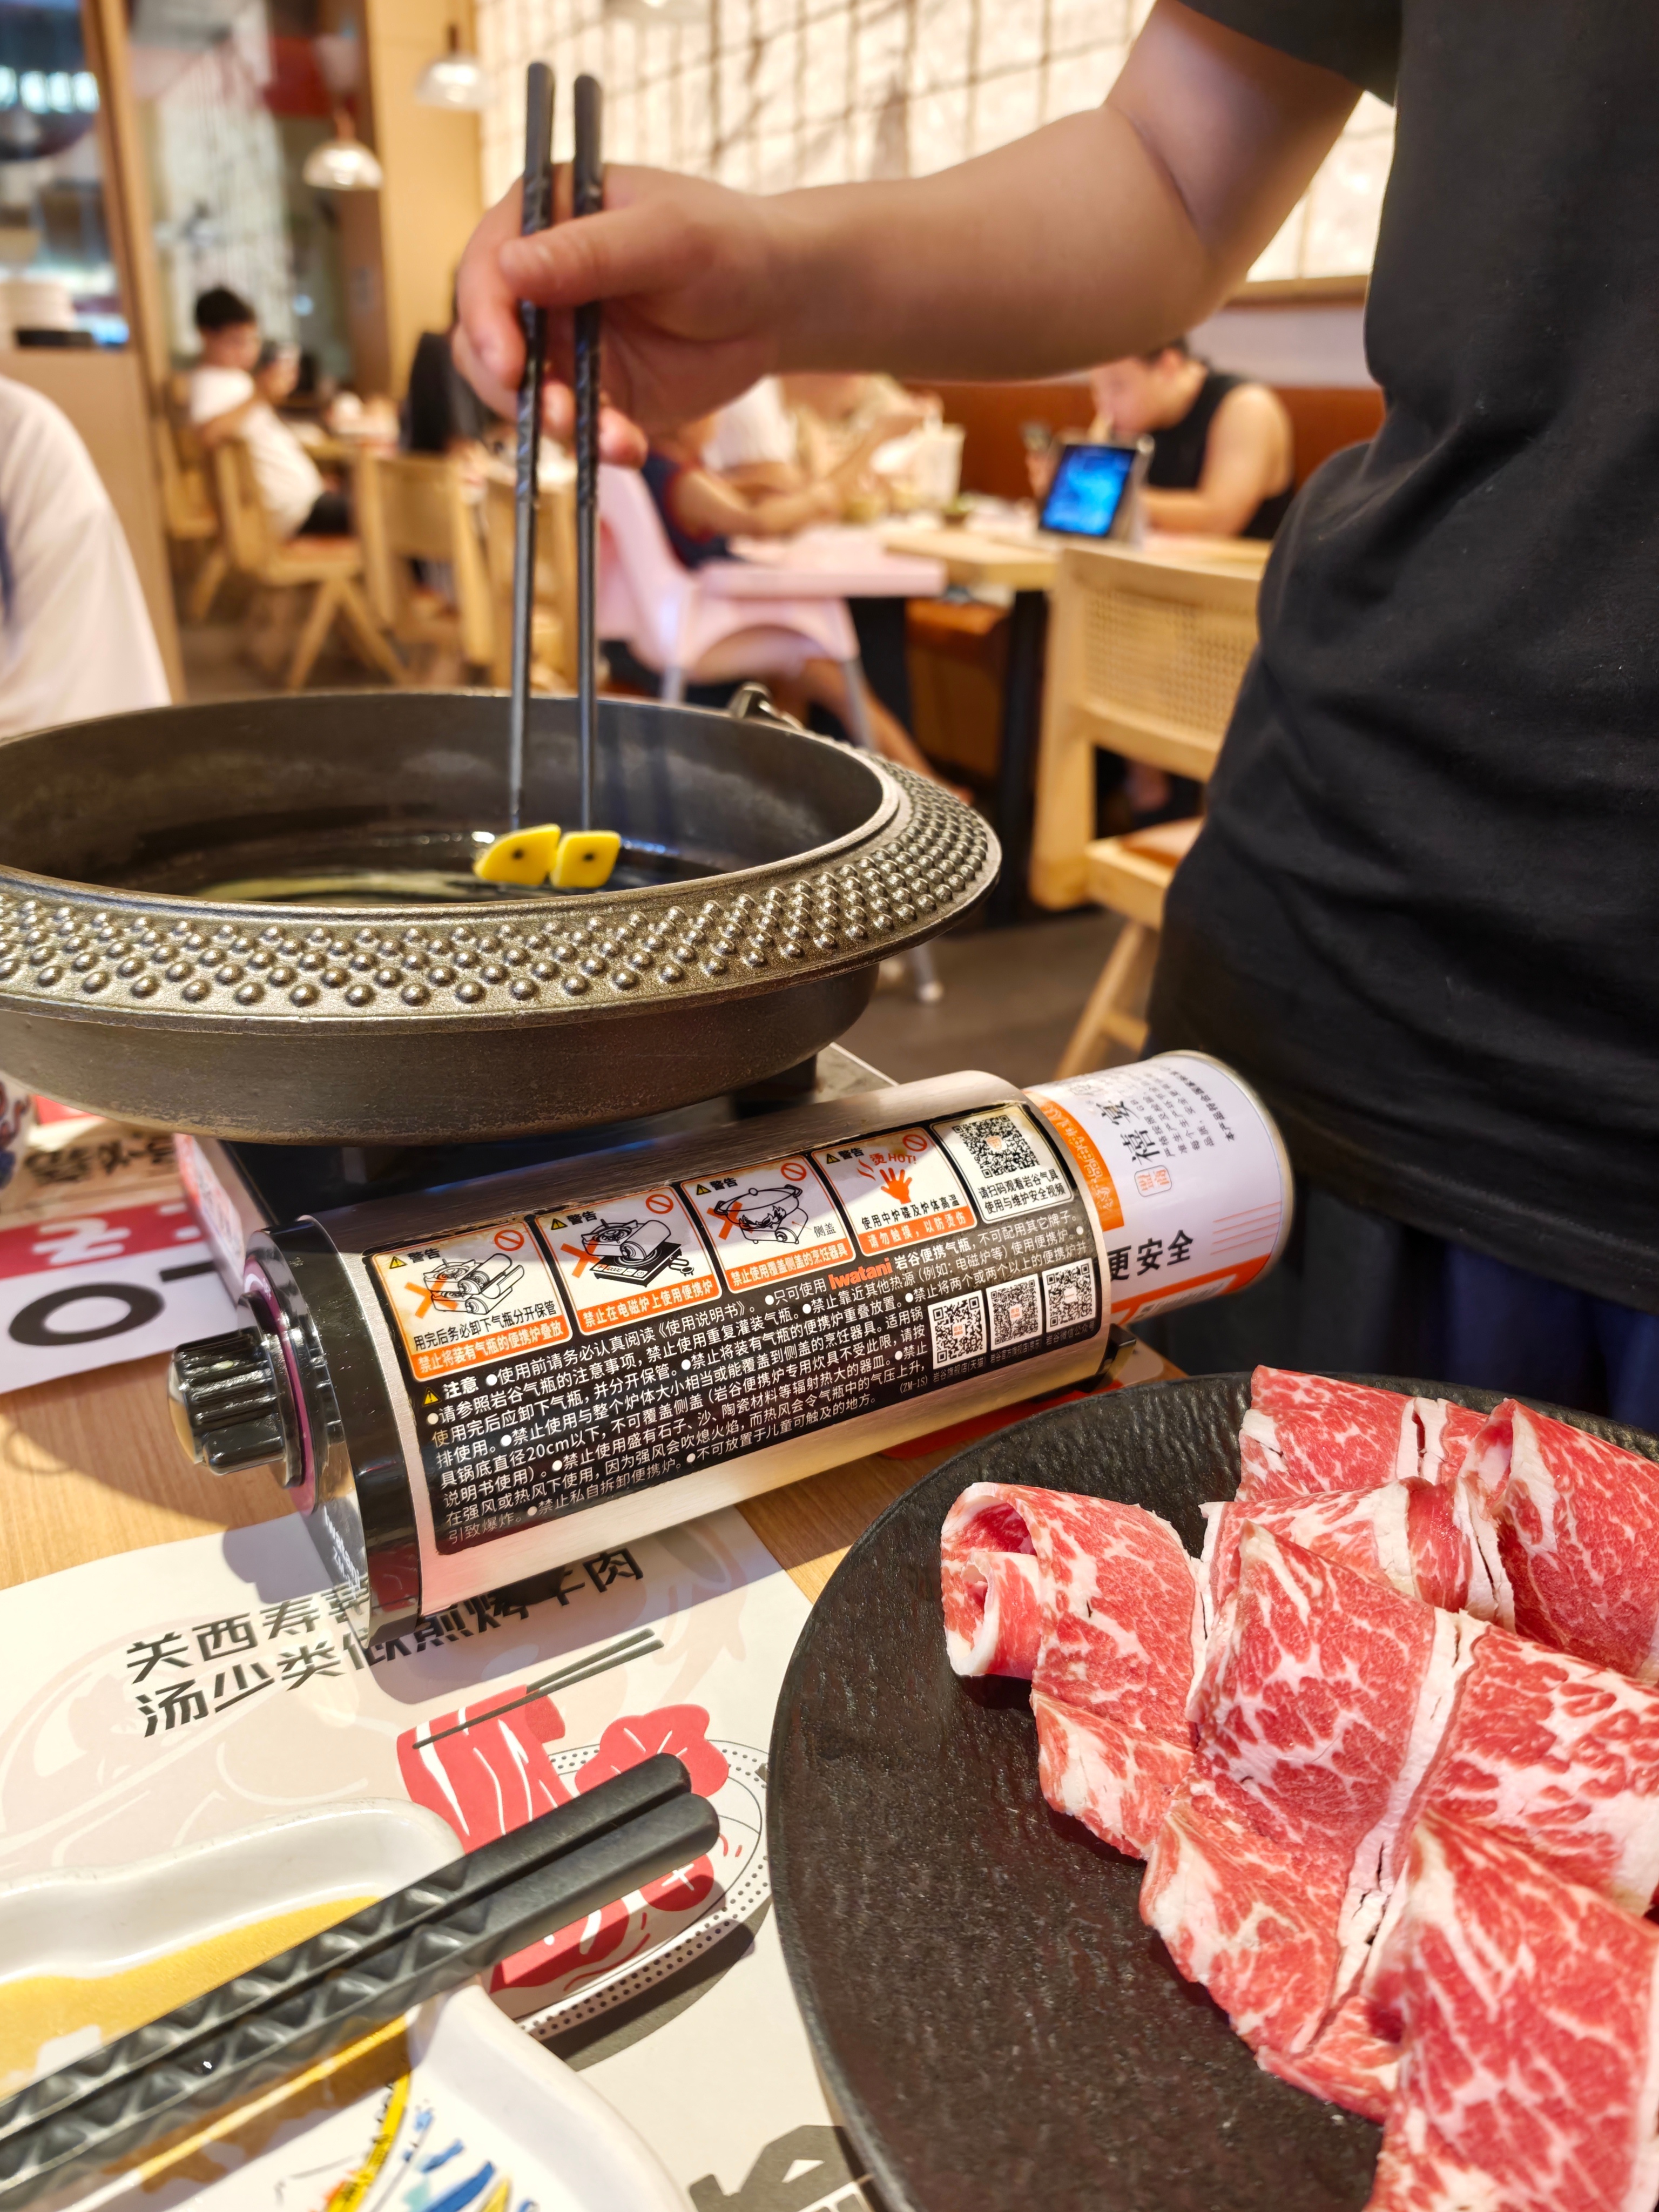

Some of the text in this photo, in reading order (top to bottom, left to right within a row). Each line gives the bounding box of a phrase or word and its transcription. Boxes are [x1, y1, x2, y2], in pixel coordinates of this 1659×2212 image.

[838, 1147, 865, 1161] 警告
[709, 1177, 738, 1191] 警告
[977, 1168, 1060, 1200] 请扫码观看岩谷气具
[984, 1183, 1066, 1215] 使用与维护安全视频
[566, 1211, 598, 1225] 警告
[861, 1193, 960, 1231] 使用中炉碟及炉体高温
[813, 1222, 837, 1238] 侧盖
[407, 1248, 440, 1264] 警告
[731, 1242, 848, 1286] 禁止使用覆盖侧盖的烹饪器具
[1107, 1230, 1194, 1283] 更安全
[583, 1279, 713, 1328] 禁止在电磁炉上使用便携炉
[413, 1300, 557, 1351] 用完后务必卸下气瓶分开保管
[442, 1375, 479, 1400] 注意
[828, 1257, 894, 1290] Iwatani
[417, 1321, 564, 1374] 禁止将装有气瓶的便携炉叠放
